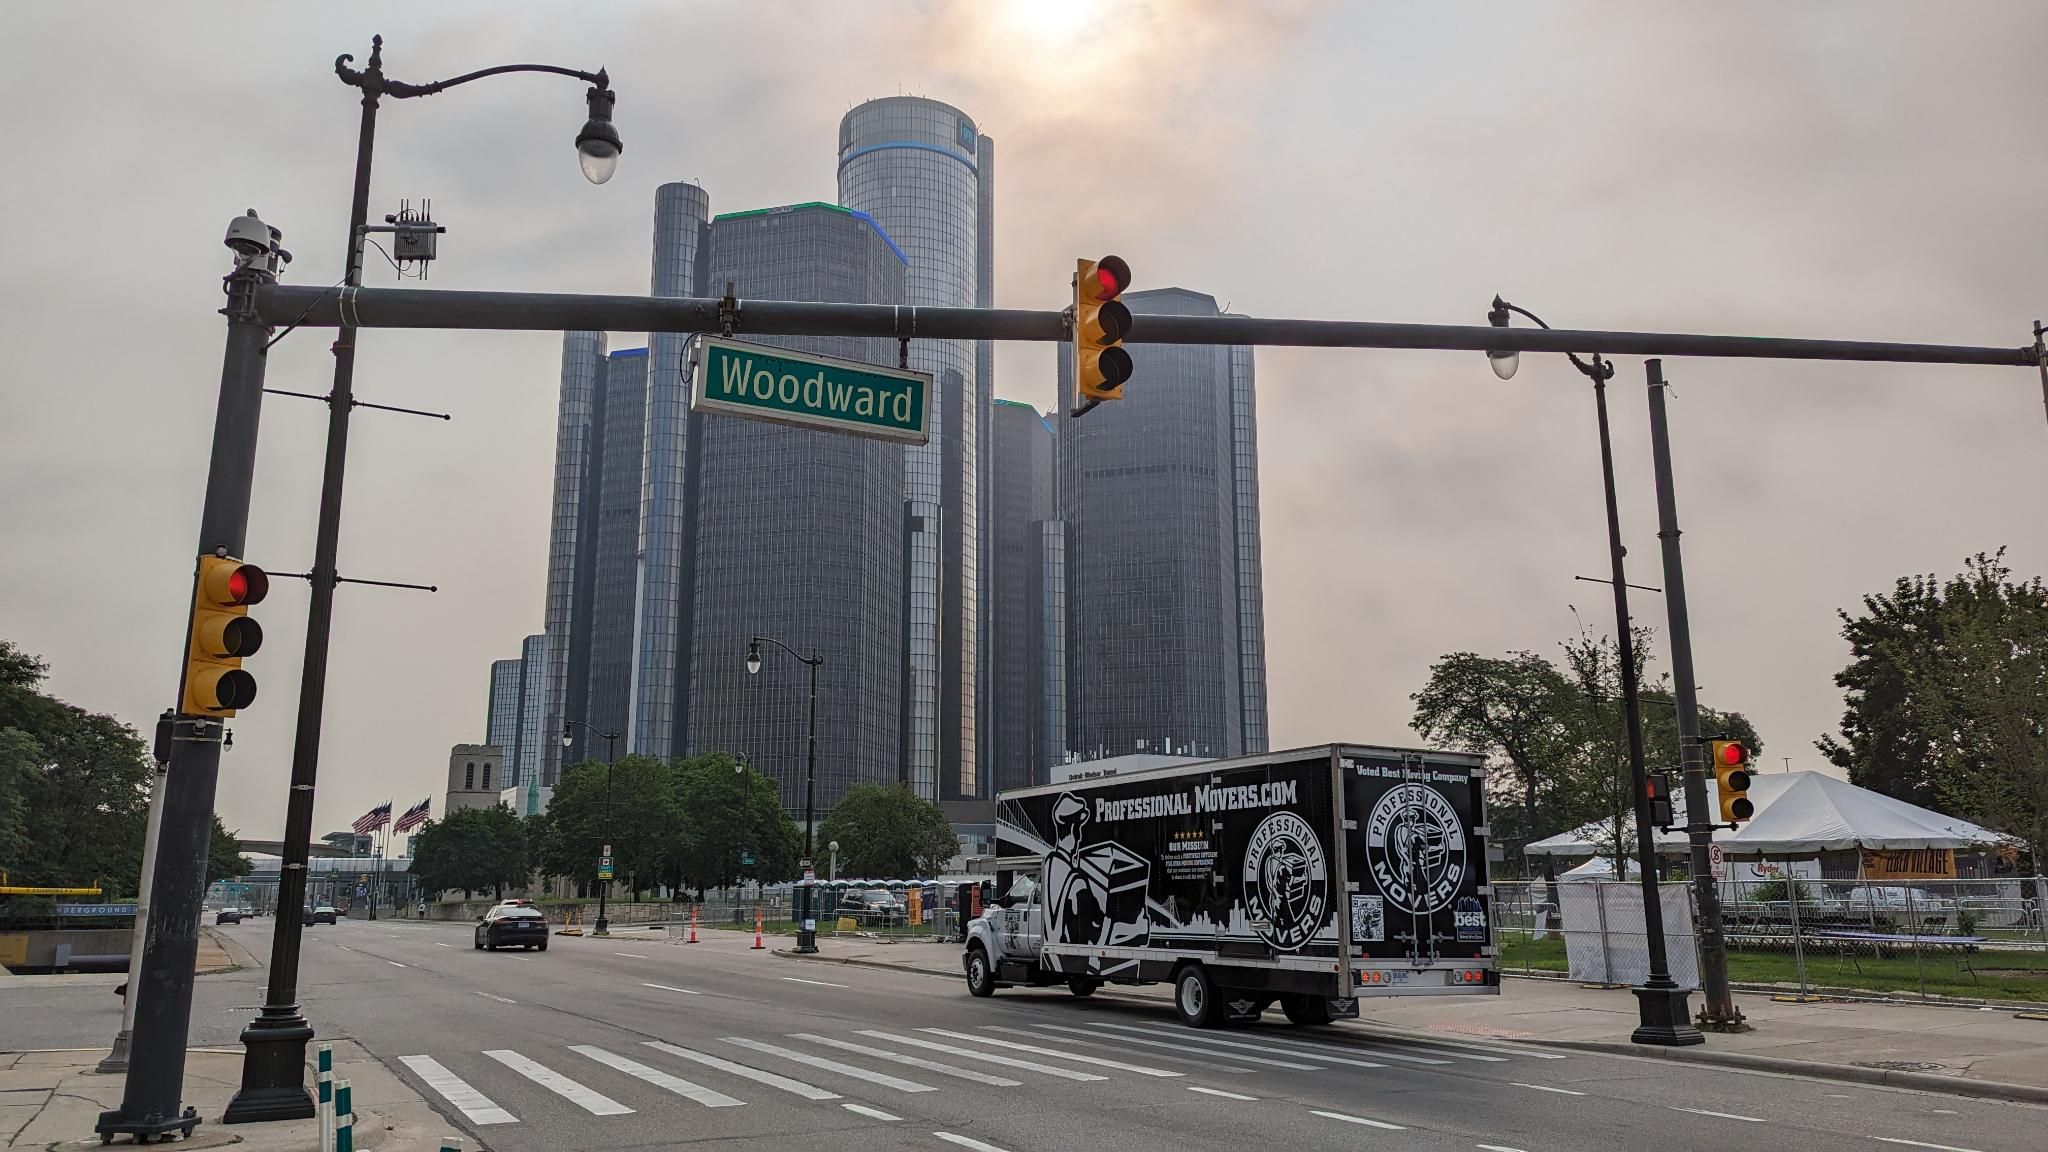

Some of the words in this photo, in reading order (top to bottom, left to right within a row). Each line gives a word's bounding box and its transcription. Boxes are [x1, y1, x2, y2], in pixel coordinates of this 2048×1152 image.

[721, 355, 913, 423] Woodward
[1356, 765, 1380, 777] Voted
[1382, 766, 1400, 778] Best
[1432, 770, 1468, 785] Company
[1372, 789, 1459, 840] PROFESSIONAL
[1248, 819, 1321, 871] PROFESSIONAL
[1911, 849, 1949, 875] VILLAGE
[1374, 860, 1461, 909] MOVERS
[1757, 863, 1779, 874] Ryder
[1453, 911, 1486, 928] best
